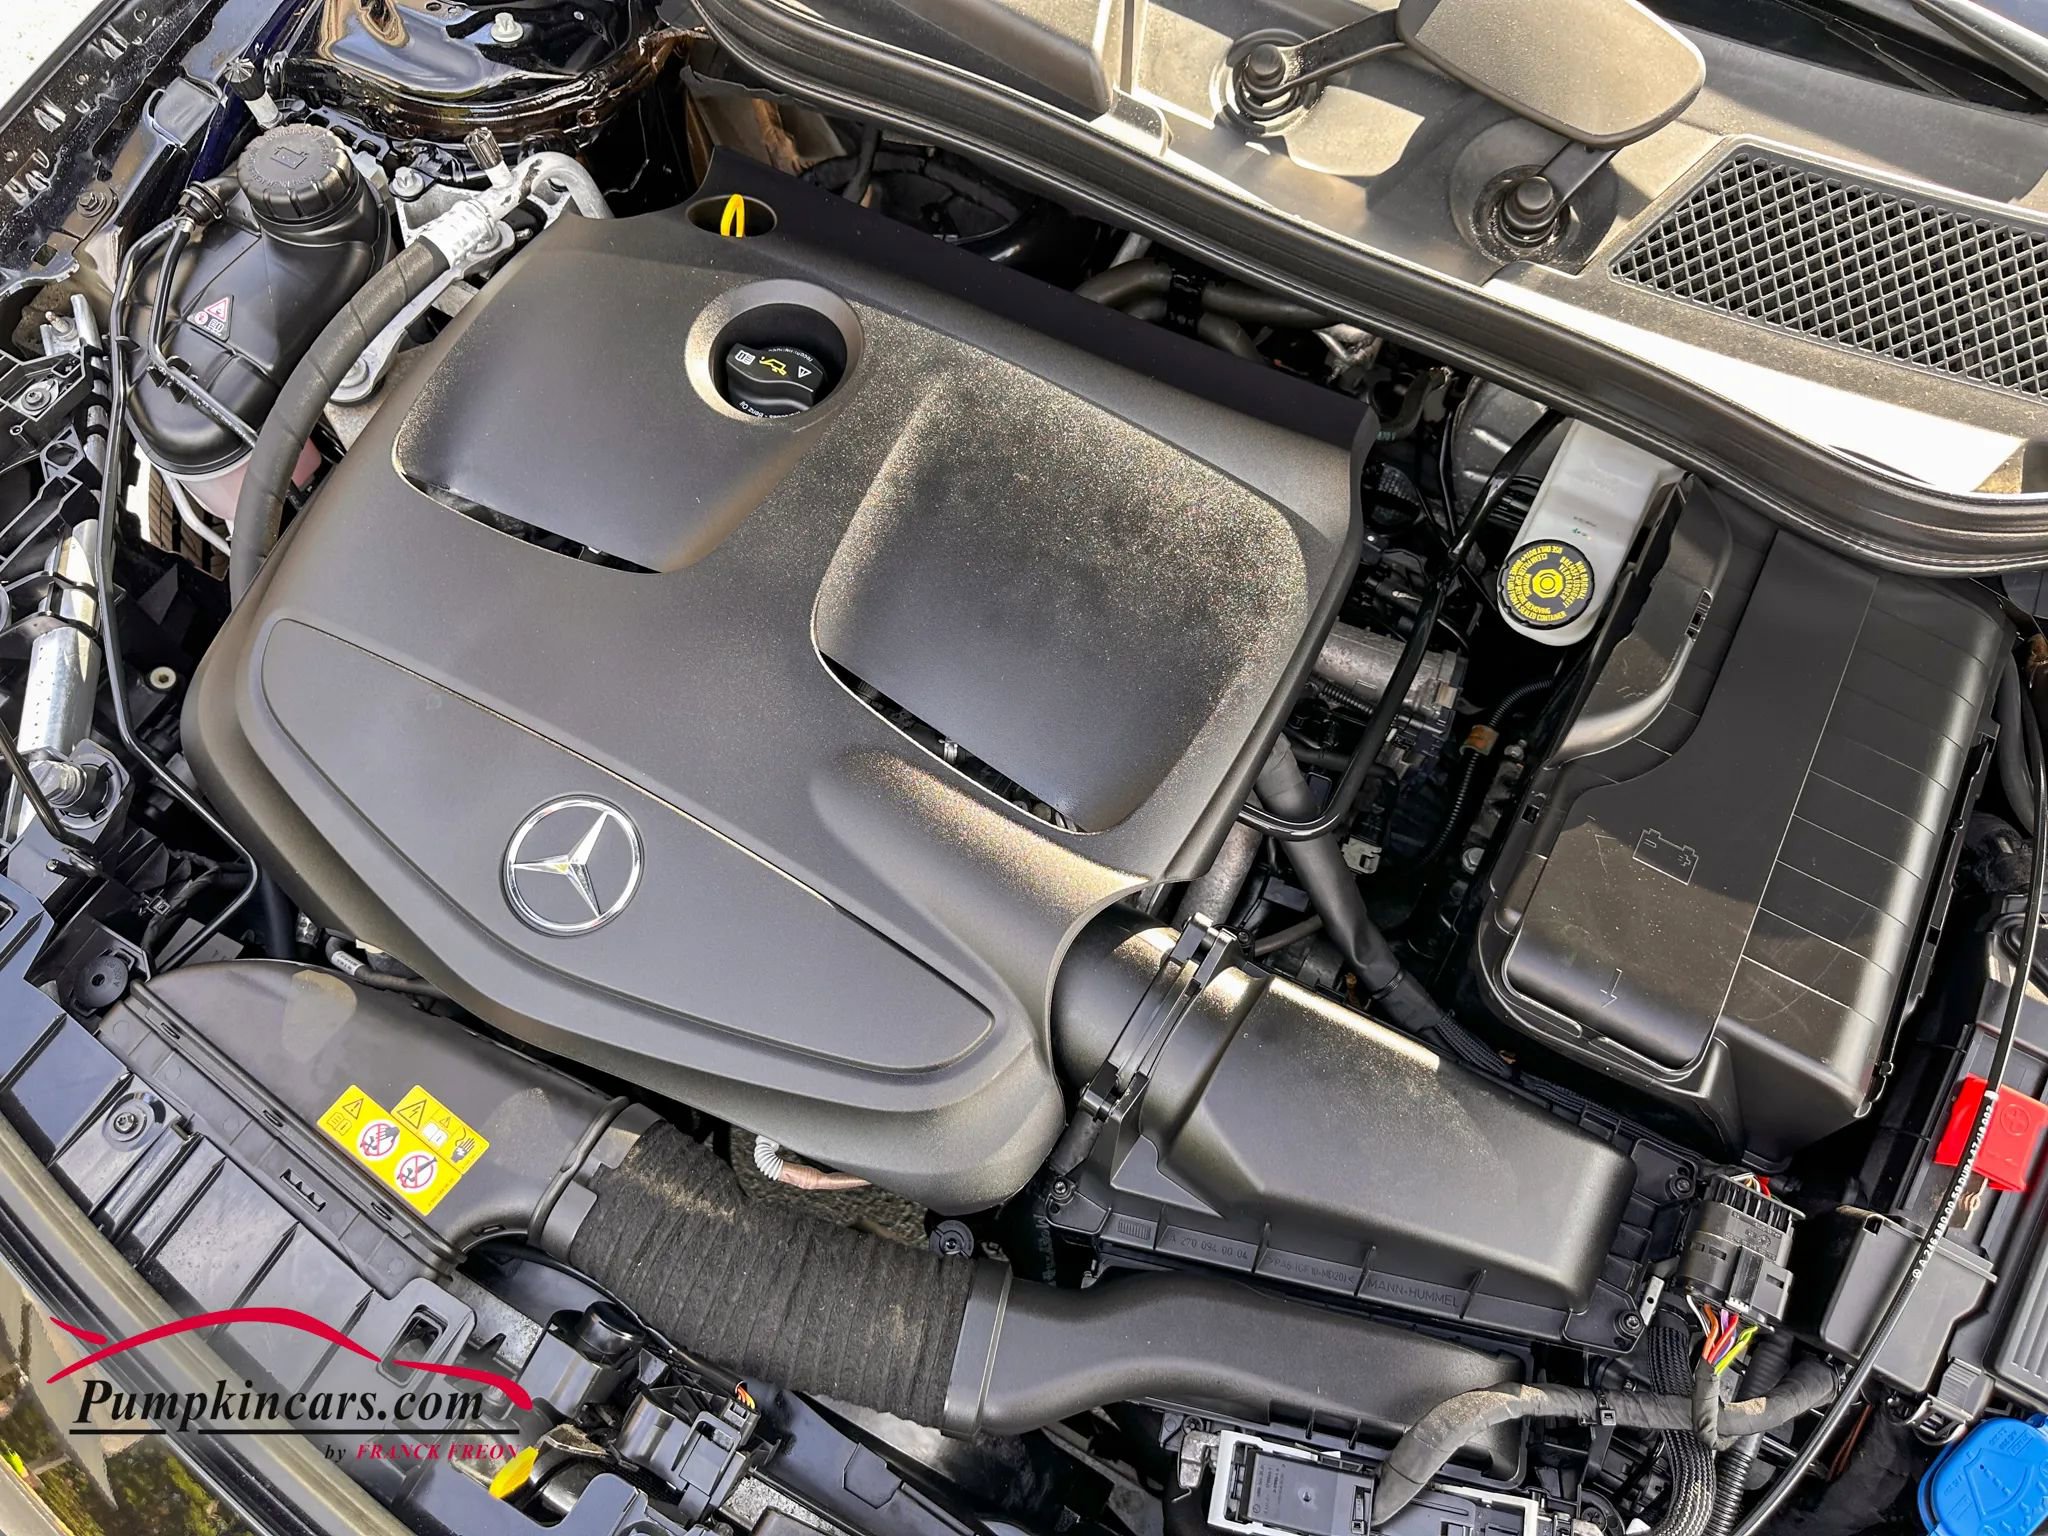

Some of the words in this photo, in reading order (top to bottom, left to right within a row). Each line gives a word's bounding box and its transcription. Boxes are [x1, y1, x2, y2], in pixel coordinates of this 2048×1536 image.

[1180, 1237, 1197, 1249] 270
[1919, 1258, 1927, 1268] A
[1924, 1238, 1938, 1257] 246
[1945, 1201, 1955, 1214] 00
[1952, 1185, 1962, 1199] 59
